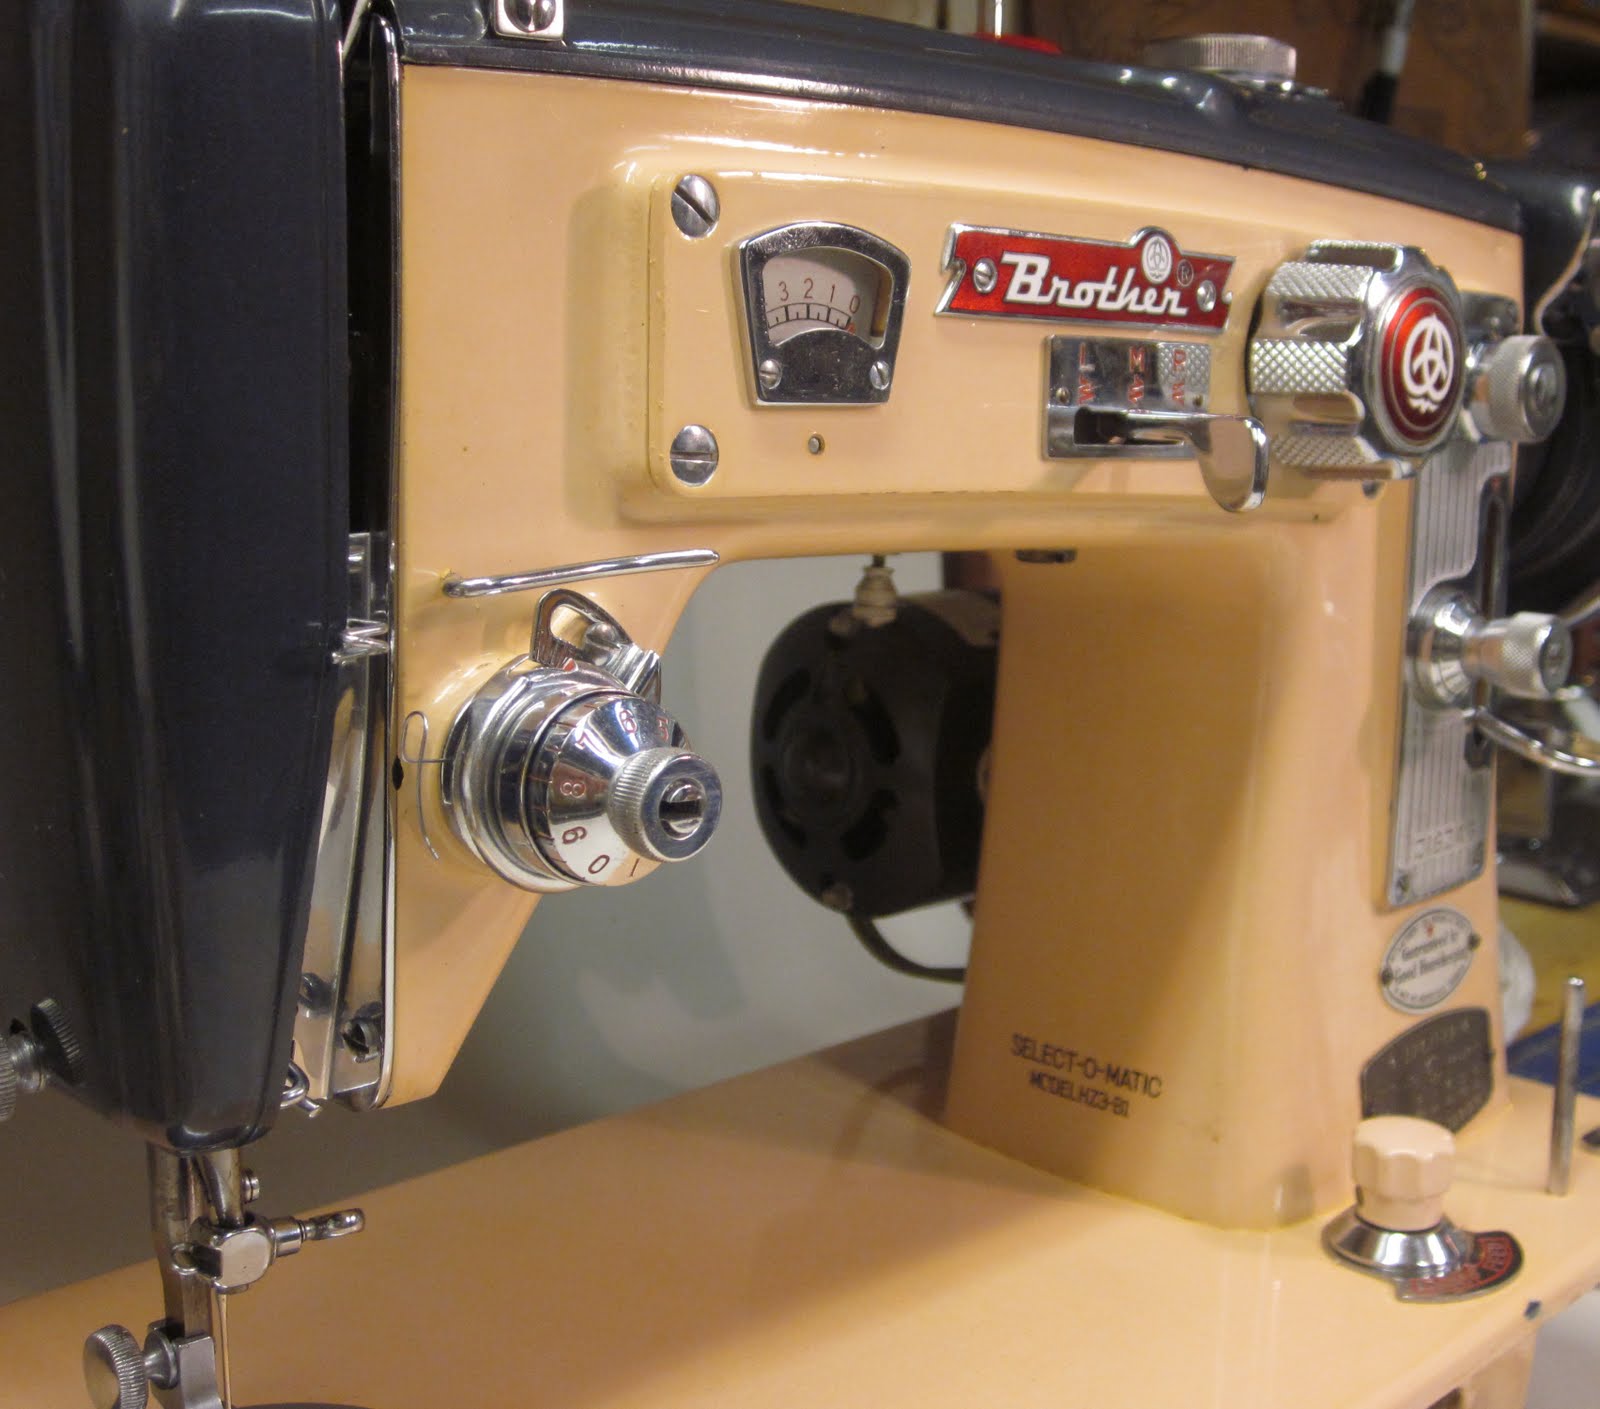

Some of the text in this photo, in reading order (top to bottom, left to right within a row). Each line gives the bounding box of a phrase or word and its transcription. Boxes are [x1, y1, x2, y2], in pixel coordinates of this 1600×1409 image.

[778, 277, 860, 315] 3 2 1 0
[1001, 251, 1188, 316] Brother
[1129, 346, 1146, 374] M
[619, 709, 637, 733] 6
[560, 780, 587, 798] 8
[588, 854, 610, 874] 0
[1011, 1032, 1163, 1099] SELECT-O-MATIC
